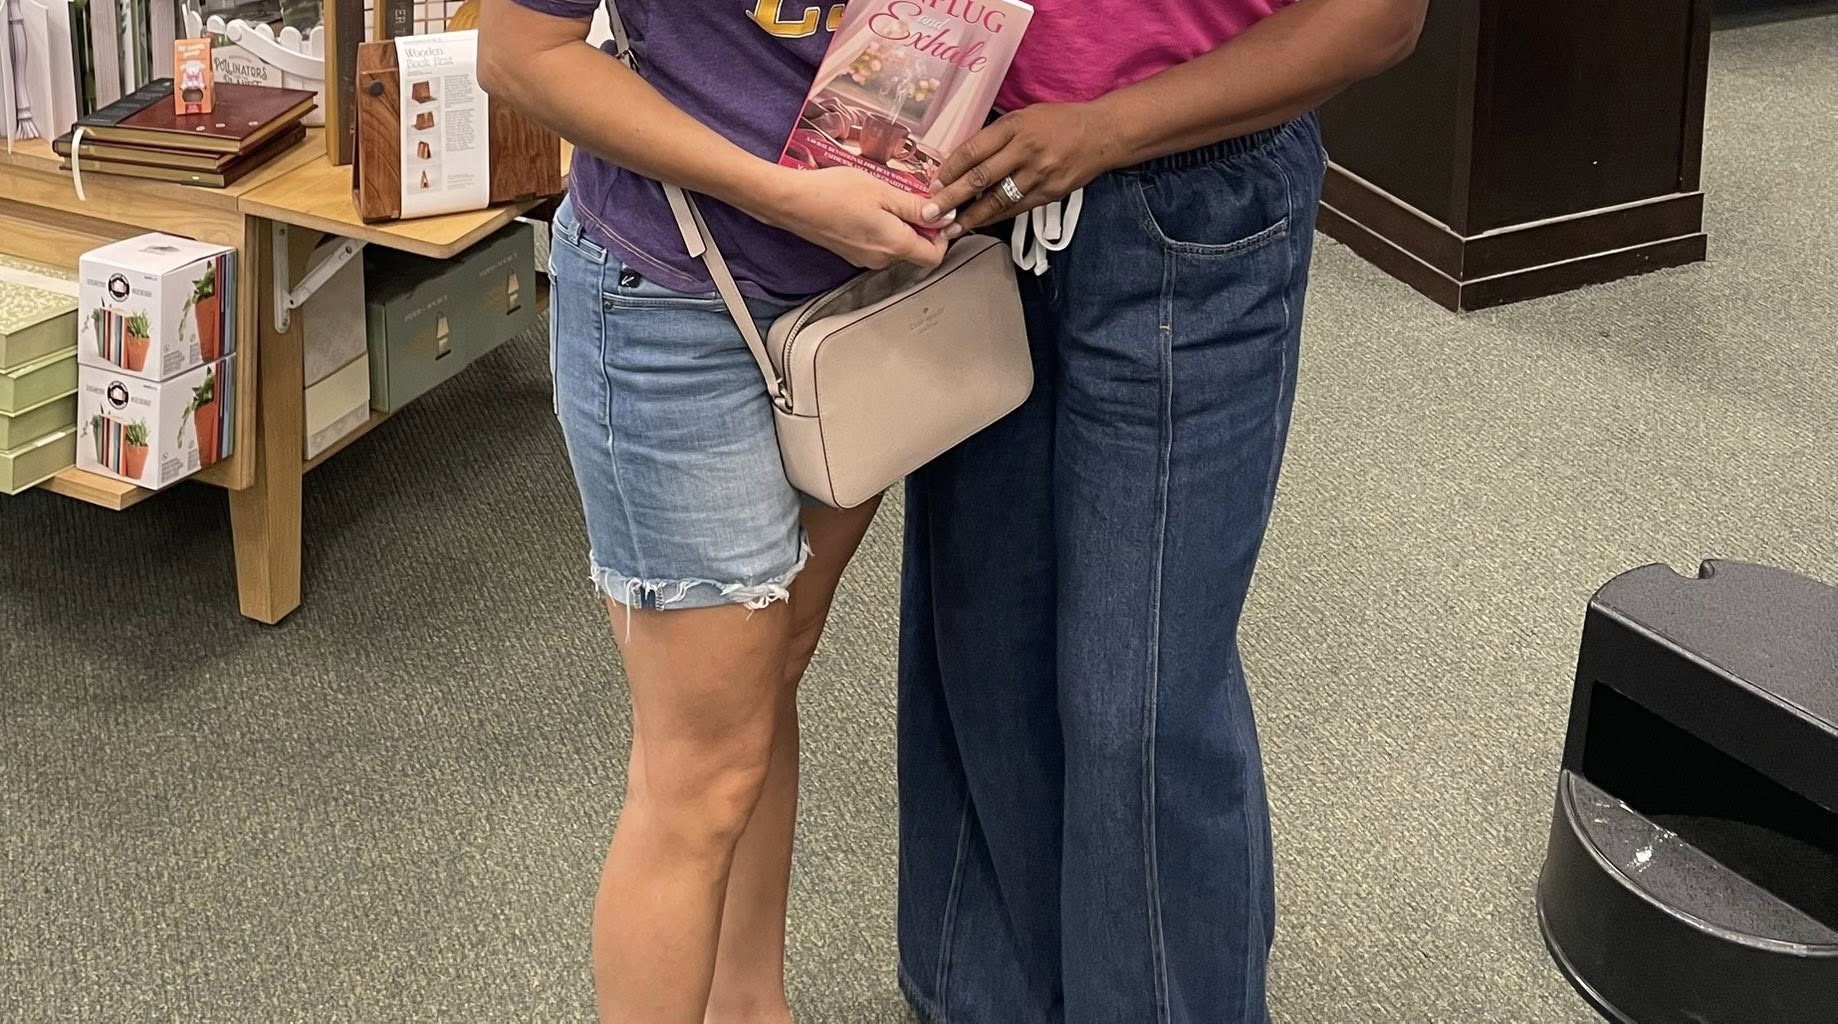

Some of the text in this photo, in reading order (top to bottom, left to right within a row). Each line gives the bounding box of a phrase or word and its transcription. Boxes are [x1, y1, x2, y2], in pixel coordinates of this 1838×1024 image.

[918, 16, 950, 31] and
[868, 0, 987, 73] Exhale
[404, 46, 444, 57] Wooden
[214, 57, 267, 80] POLLINATORS
